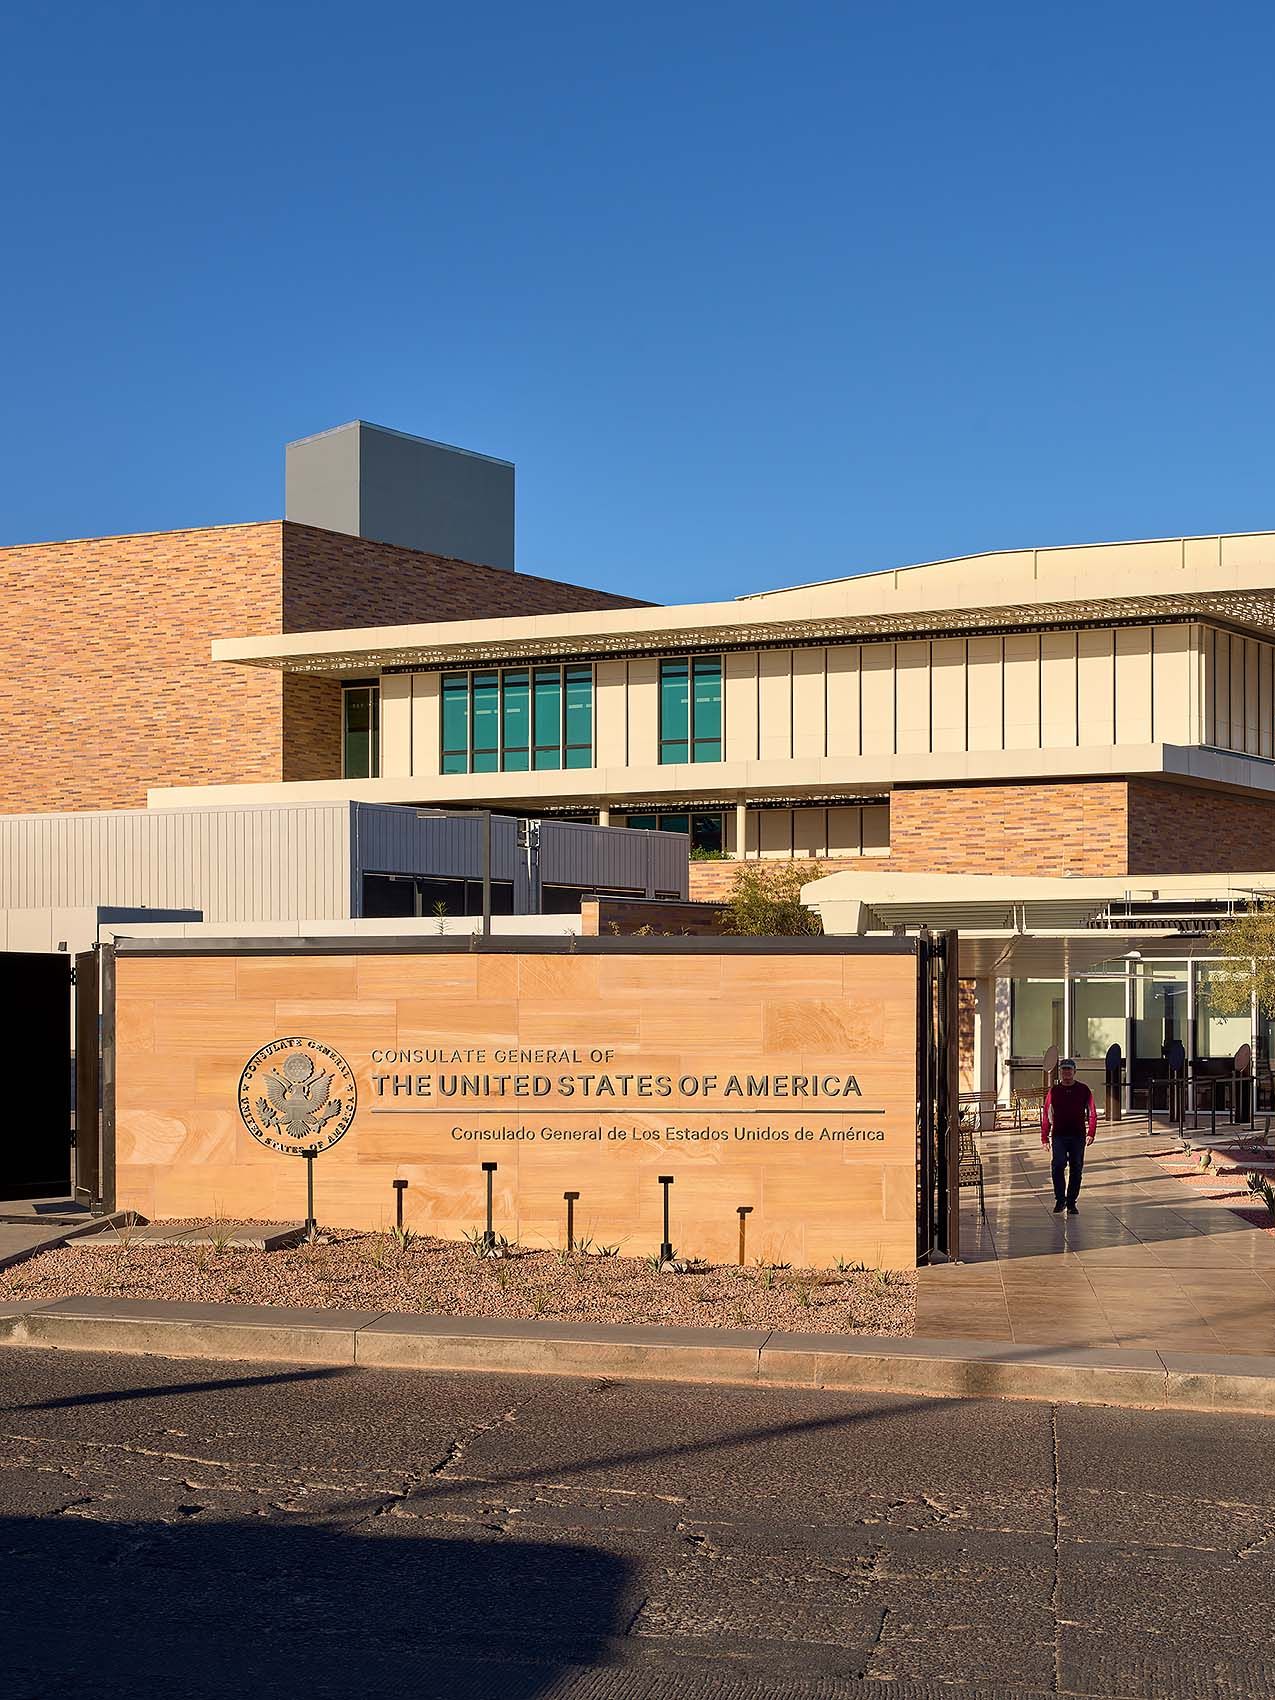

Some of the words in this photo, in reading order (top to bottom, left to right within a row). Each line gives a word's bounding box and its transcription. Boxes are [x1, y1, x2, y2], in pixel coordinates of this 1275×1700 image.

[371, 1049, 486, 1064] CONSULATE
[494, 1049, 583, 1064] GENERAL
[590, 1049, 615, 1064] OF
[371, 1074, 432, 1097] THE
[438, 1074, 552, 1097] UNITED
[557, 1074, 673, 1097] STATES
[678, 1074, 719, 1097] OF
[723, 1074, 863, 1097] AMERICA
[240, 1096, 264, 1137] UNITED
[309, 1140, 326, 1151] OF
[451, 1126, 536, 1141] Consulado
[540, 1126, 602, 1141] General
[607, 1126, 627, 1141] de
[632, 1127, 660, 1141] Los
[666, 1126, 729, 1141] Estados
[734, 1126, 790, 1141] Unidos
[794, 1126, 814, 1141] de
[818, 1125, 885, 1141] América
